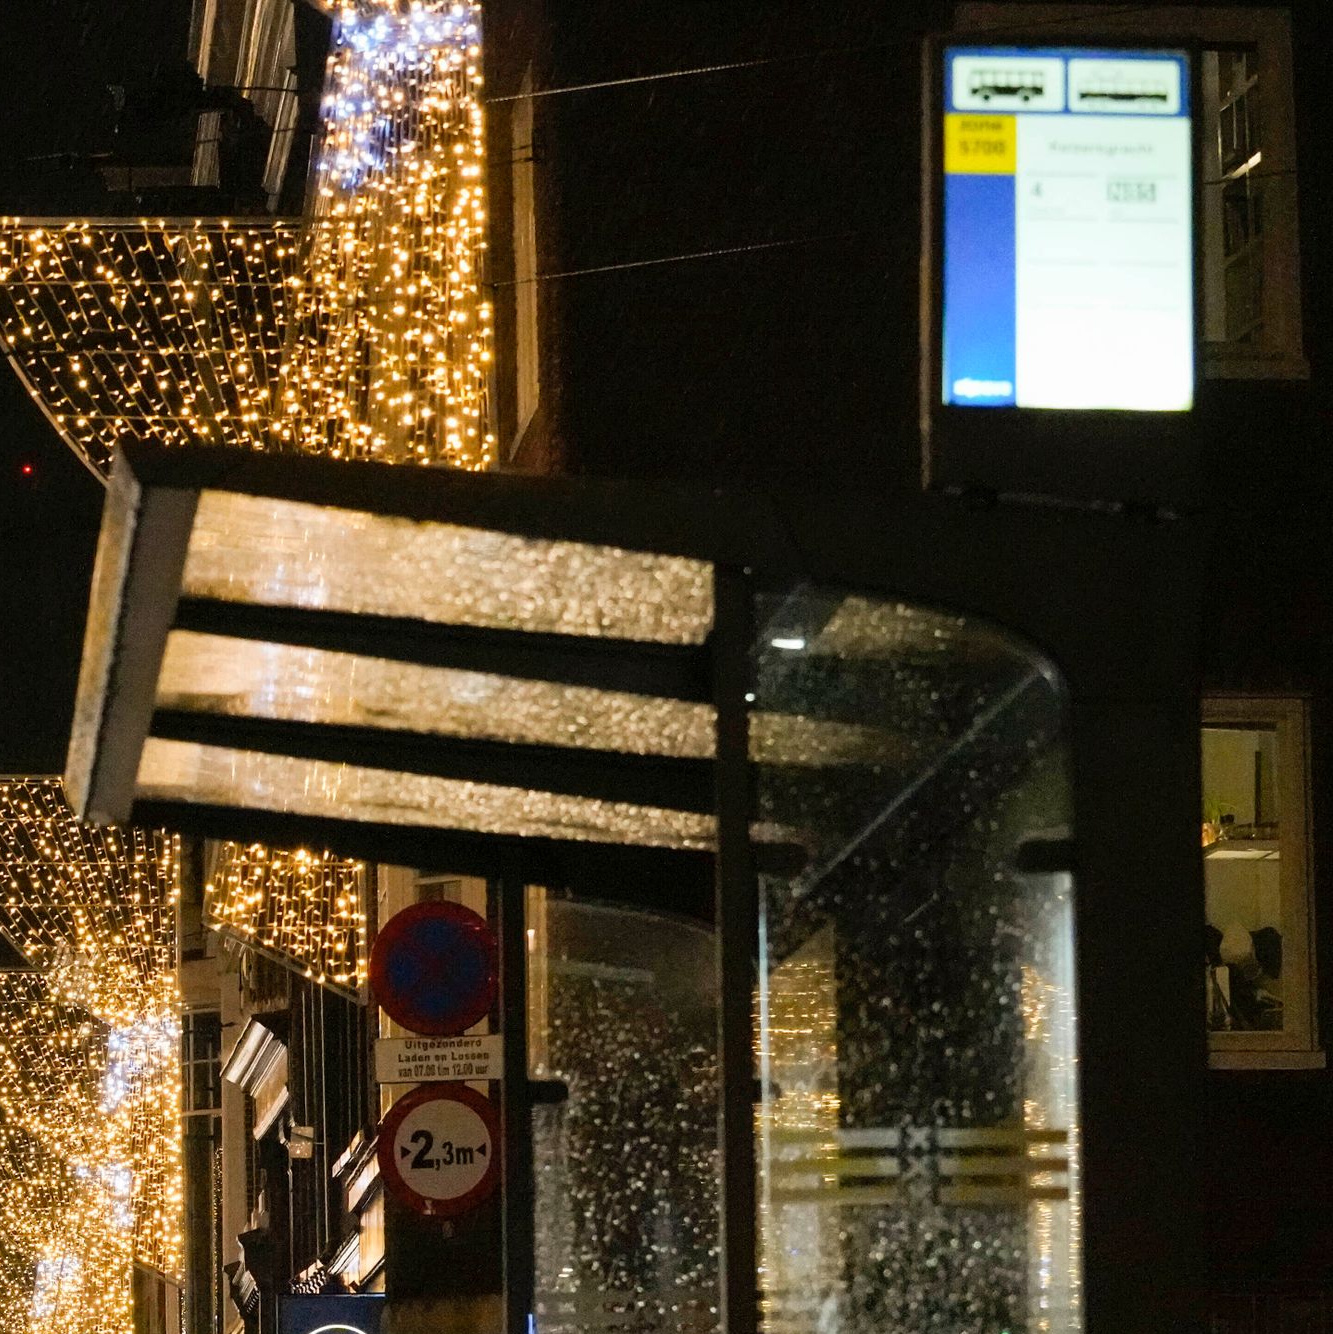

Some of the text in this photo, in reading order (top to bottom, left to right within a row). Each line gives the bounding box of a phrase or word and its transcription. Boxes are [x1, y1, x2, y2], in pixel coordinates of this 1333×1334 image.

[405, 1039, 482, 1051] Uitgezonderd
[398, 1053, 430, 1062] Laden
[451, 1052, 490, 1061] Lossen
[398, 1067, 412, 1077] van
[410, 1129, 474, 1171] 2,3m
